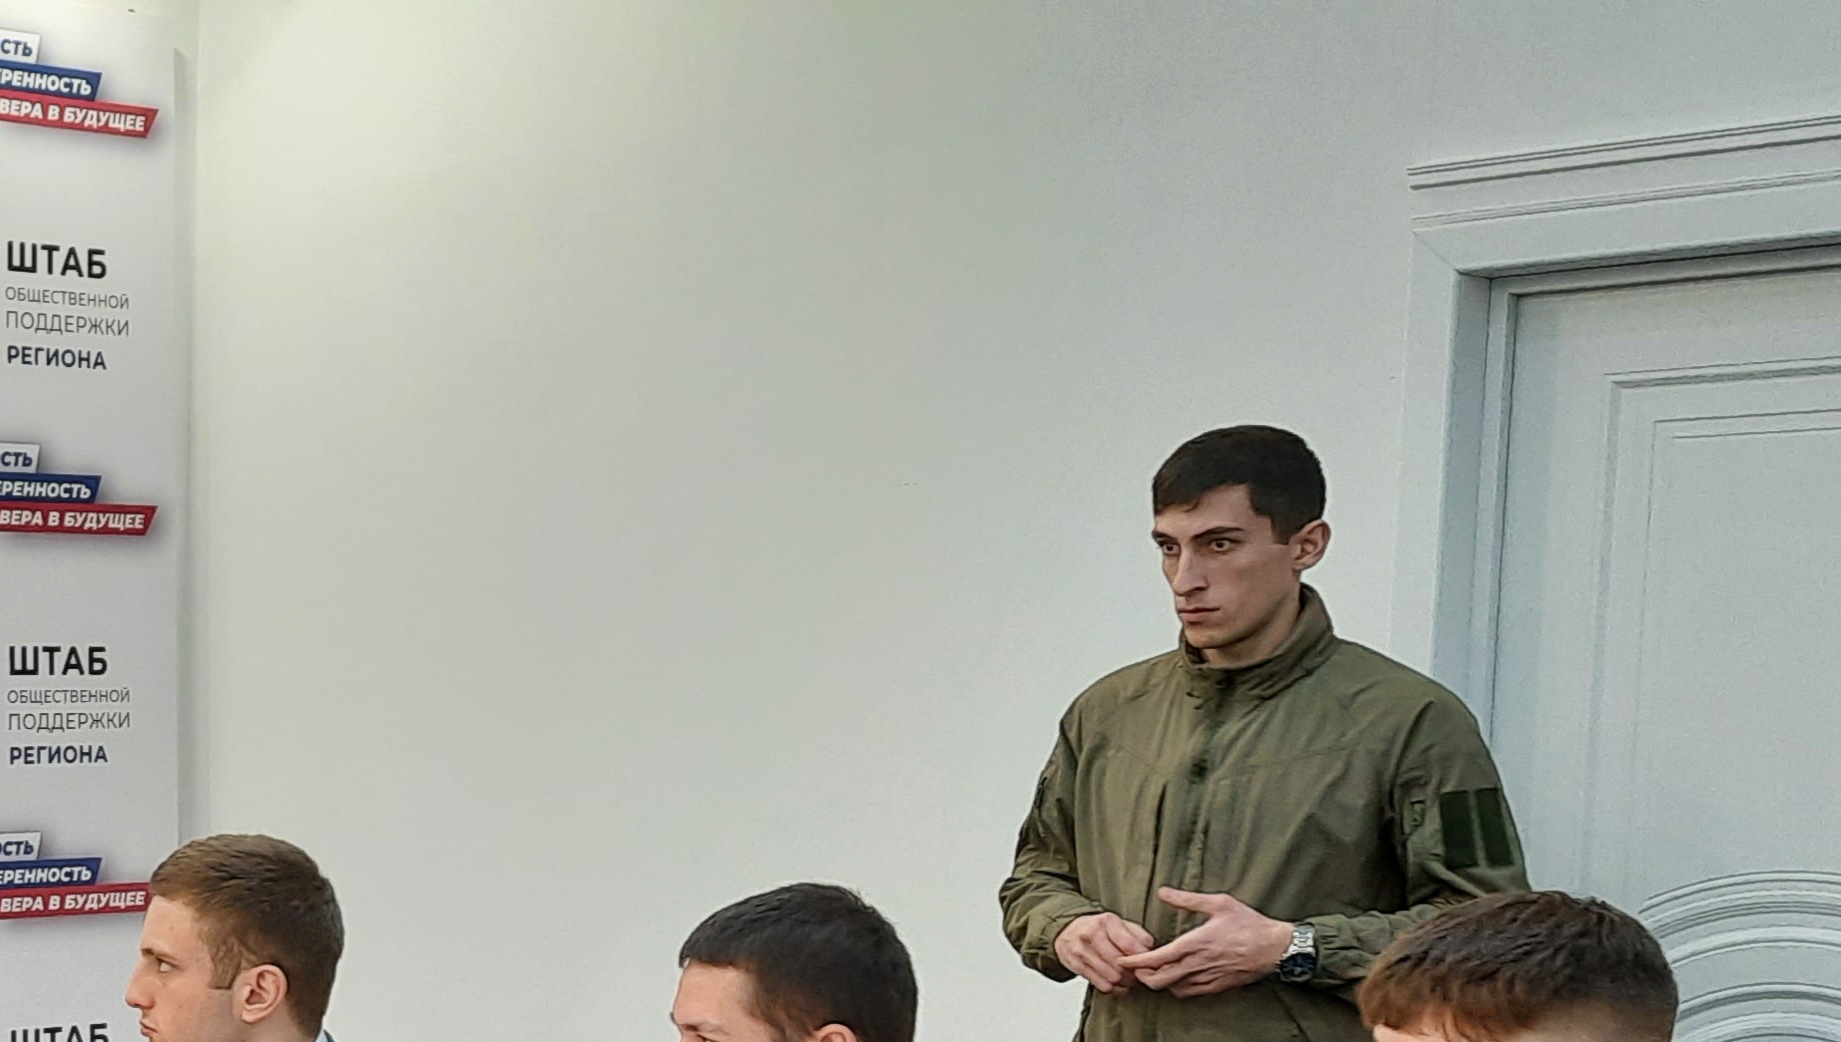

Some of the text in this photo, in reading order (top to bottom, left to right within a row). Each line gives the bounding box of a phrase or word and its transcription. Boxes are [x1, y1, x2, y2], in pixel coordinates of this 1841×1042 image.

[47, 104, 59, 121] В
[63, 105, 146, 131] БУДУЩЕЕ
[6, 240, 107, 279] ШТАБ
[5, 286, 129, 310] ОБЩЕСТВЕННОЙ
[5, 310, 129, 337] ПОДДЕРЖКИ
[6, 345, 107, 370] РЕГИОНА
[48, 510, 59, 526] В
[63, 512, 144, 531] БУДУЩЕЕ
[8, 646, 108, 676] ШТАБ
[7, 686, 131, 706] ОБЩЕСТВЕННОЙ
[8, 712, 131, 733] ПОДДЕРЖКИ
[9, 744, 108, 765] РЕГИОНА
[0, 891, 146, 914] ВЕРА В БУДУЩЕЕ
